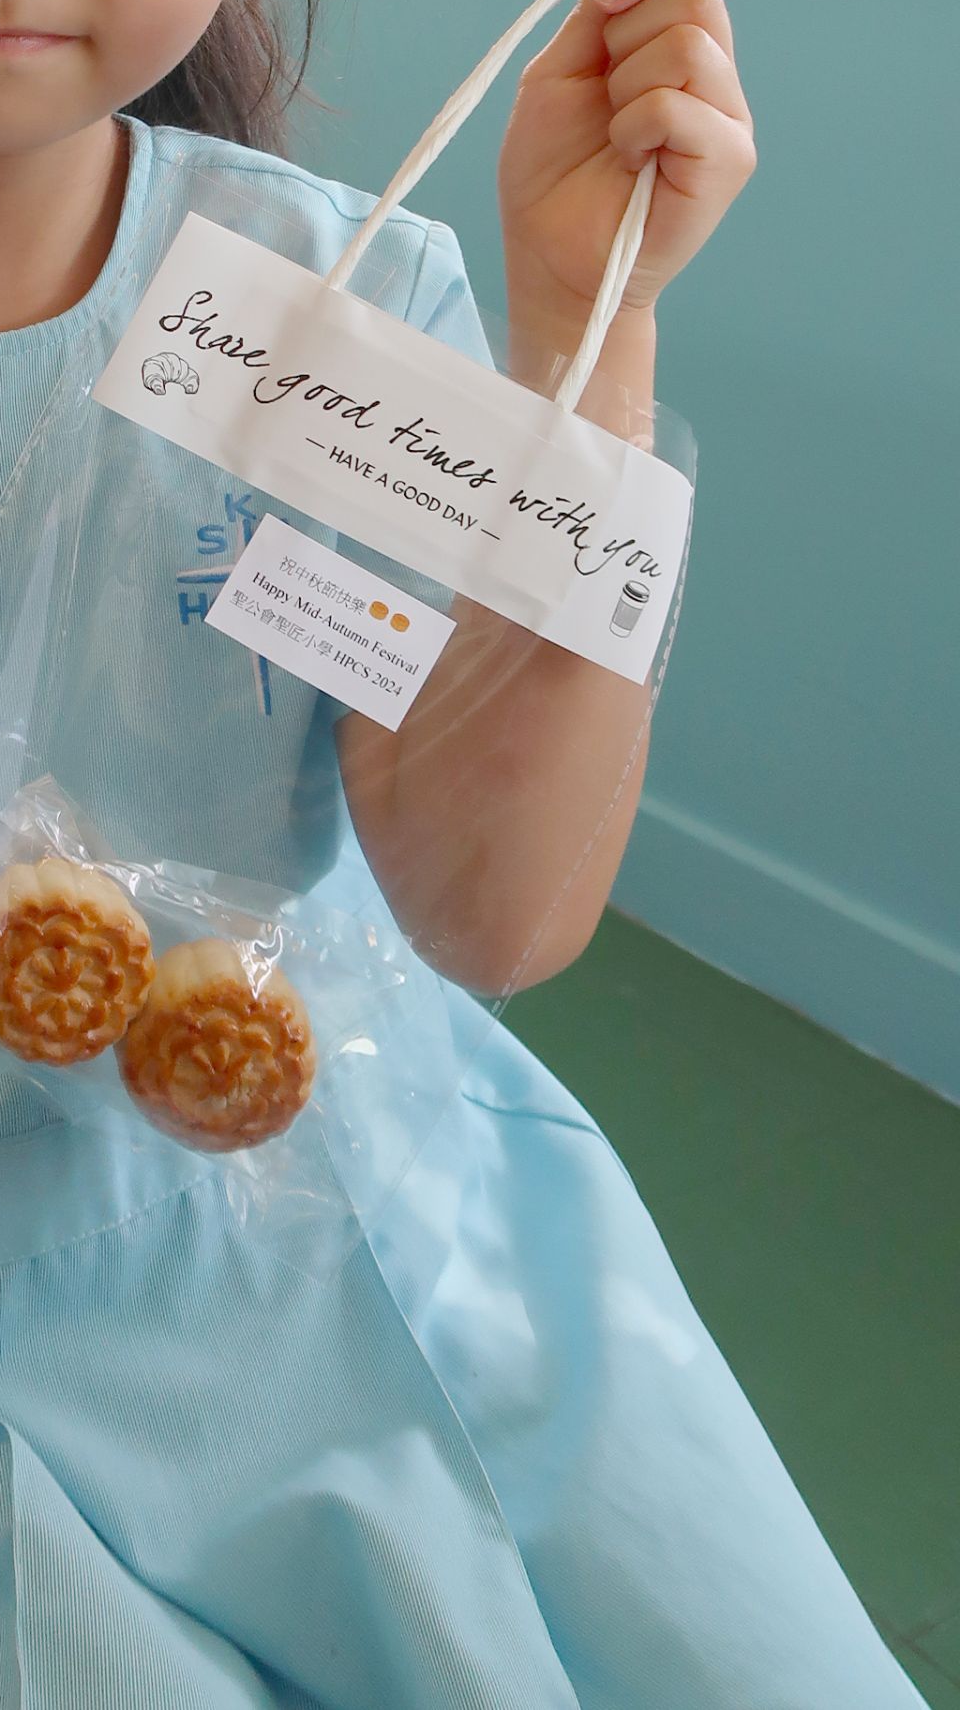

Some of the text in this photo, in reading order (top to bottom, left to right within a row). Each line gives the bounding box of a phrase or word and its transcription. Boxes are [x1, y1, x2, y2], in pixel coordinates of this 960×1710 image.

[159, 290, 662, 577] Share good times with you
[329, 446, 478, 531] HAVE A GOOD DAY
[252, 571, 420, 676] Happy Mid-Autumn Festival
[278, 555, 368, 616] 祝中秋節快樂
[229, 589, 404, 697] 聖公會聖匠小學 HPCS 2024
